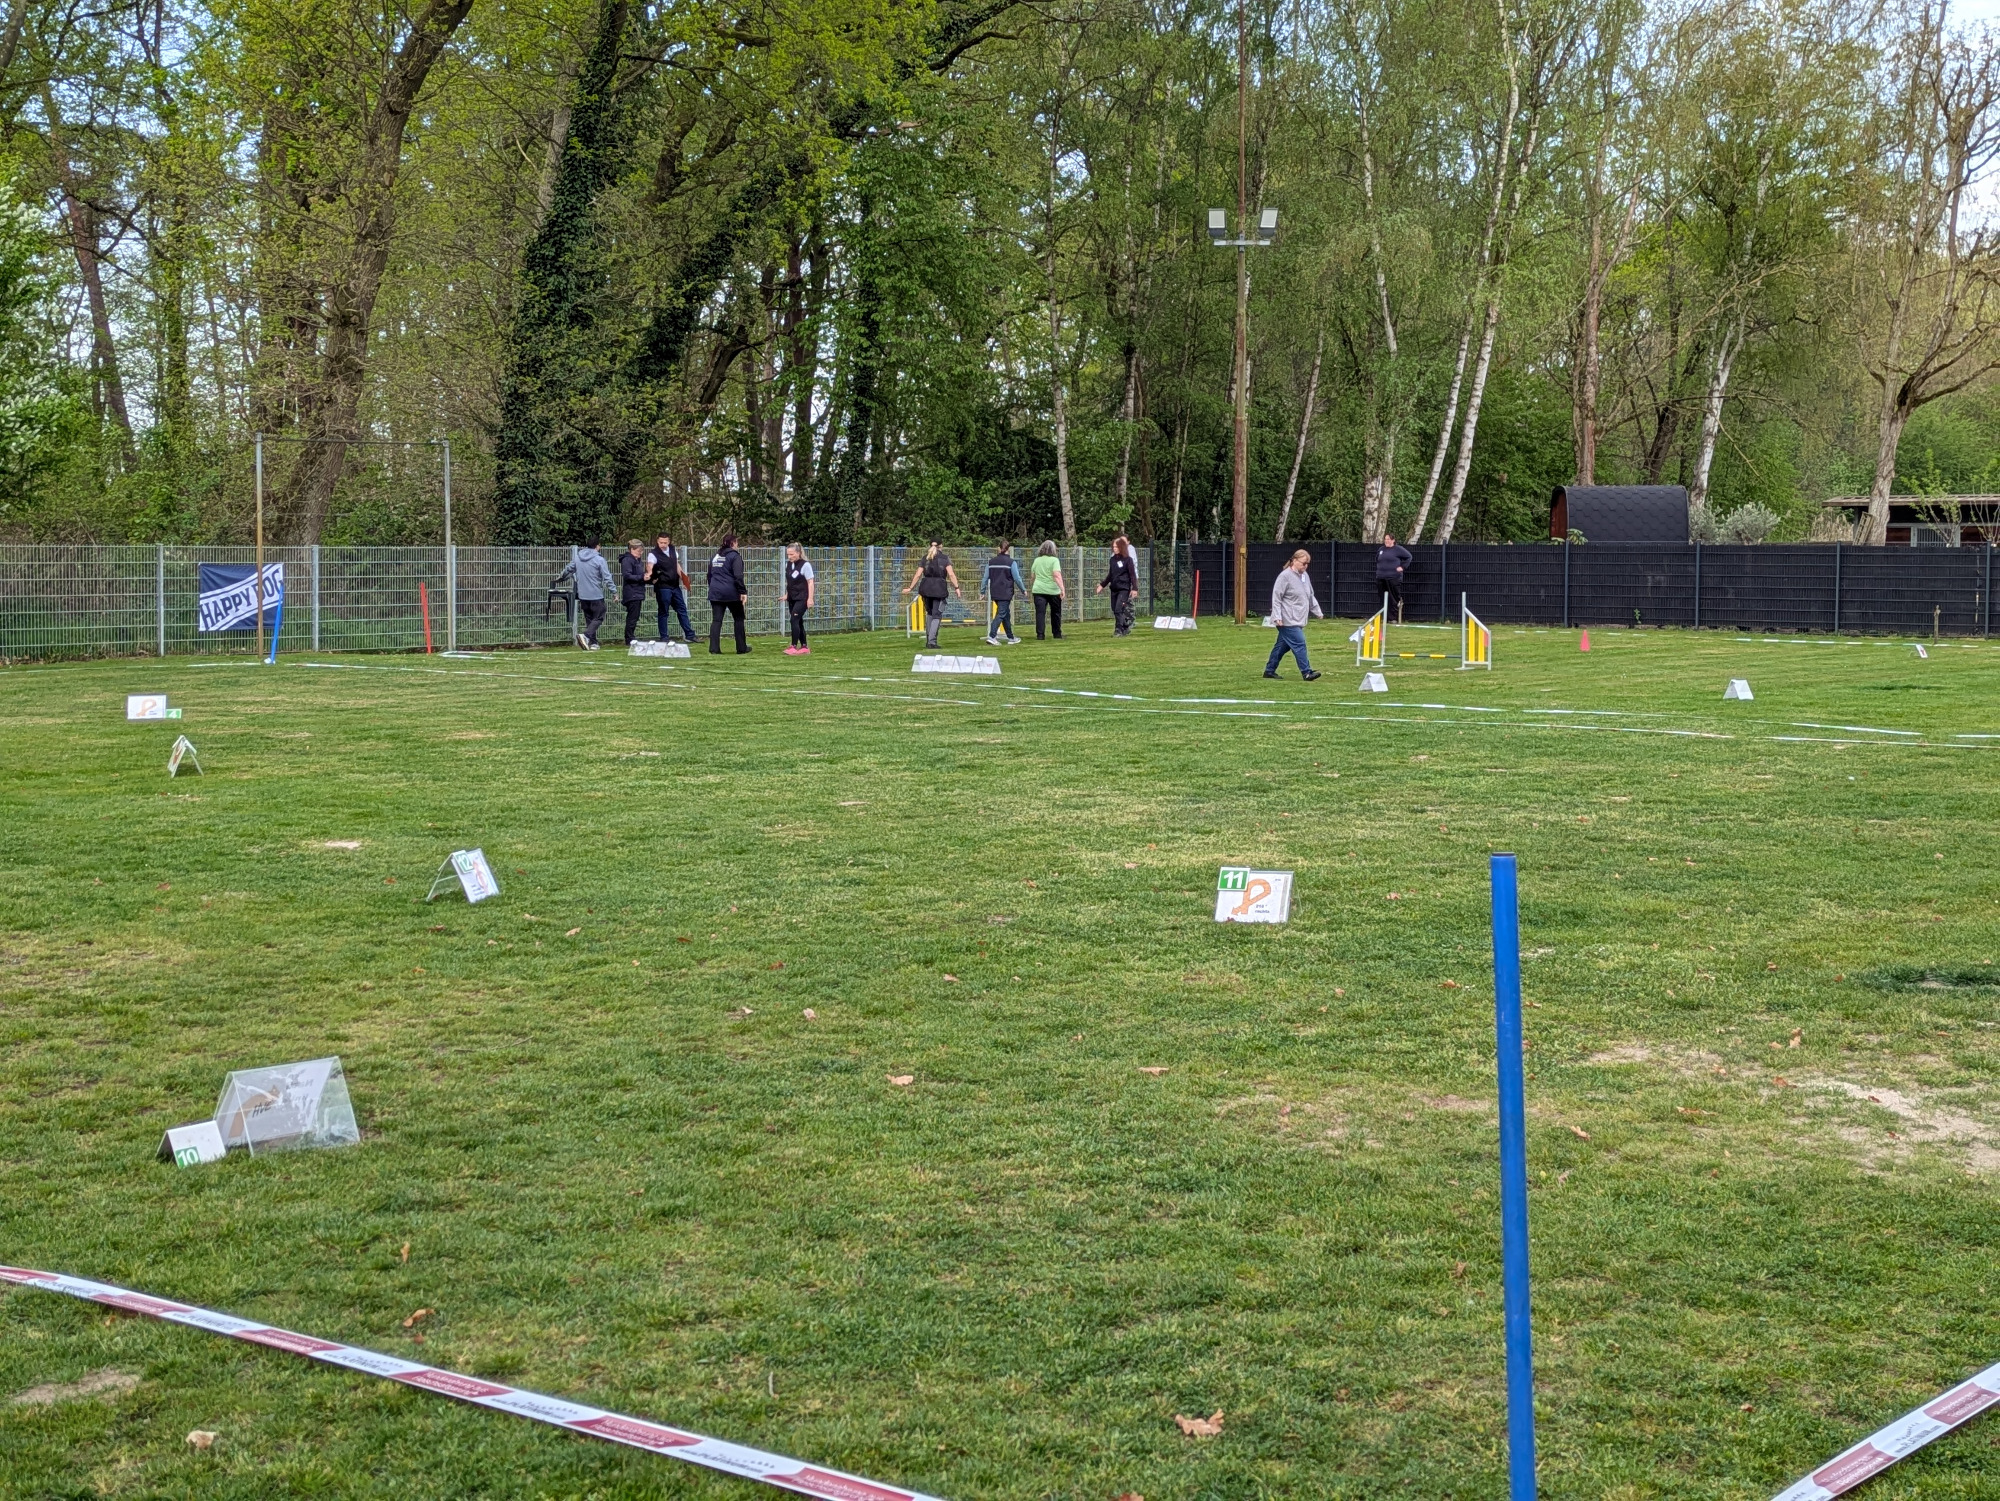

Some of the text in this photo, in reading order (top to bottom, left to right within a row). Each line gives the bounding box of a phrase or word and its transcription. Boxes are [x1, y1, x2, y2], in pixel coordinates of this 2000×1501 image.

[200, 587, 252, 629] HAPPY
[168, 710, 177, 718] 4
[1223, 871, 1244, 888] 11
[177, 1148, 199, 1167] 10
